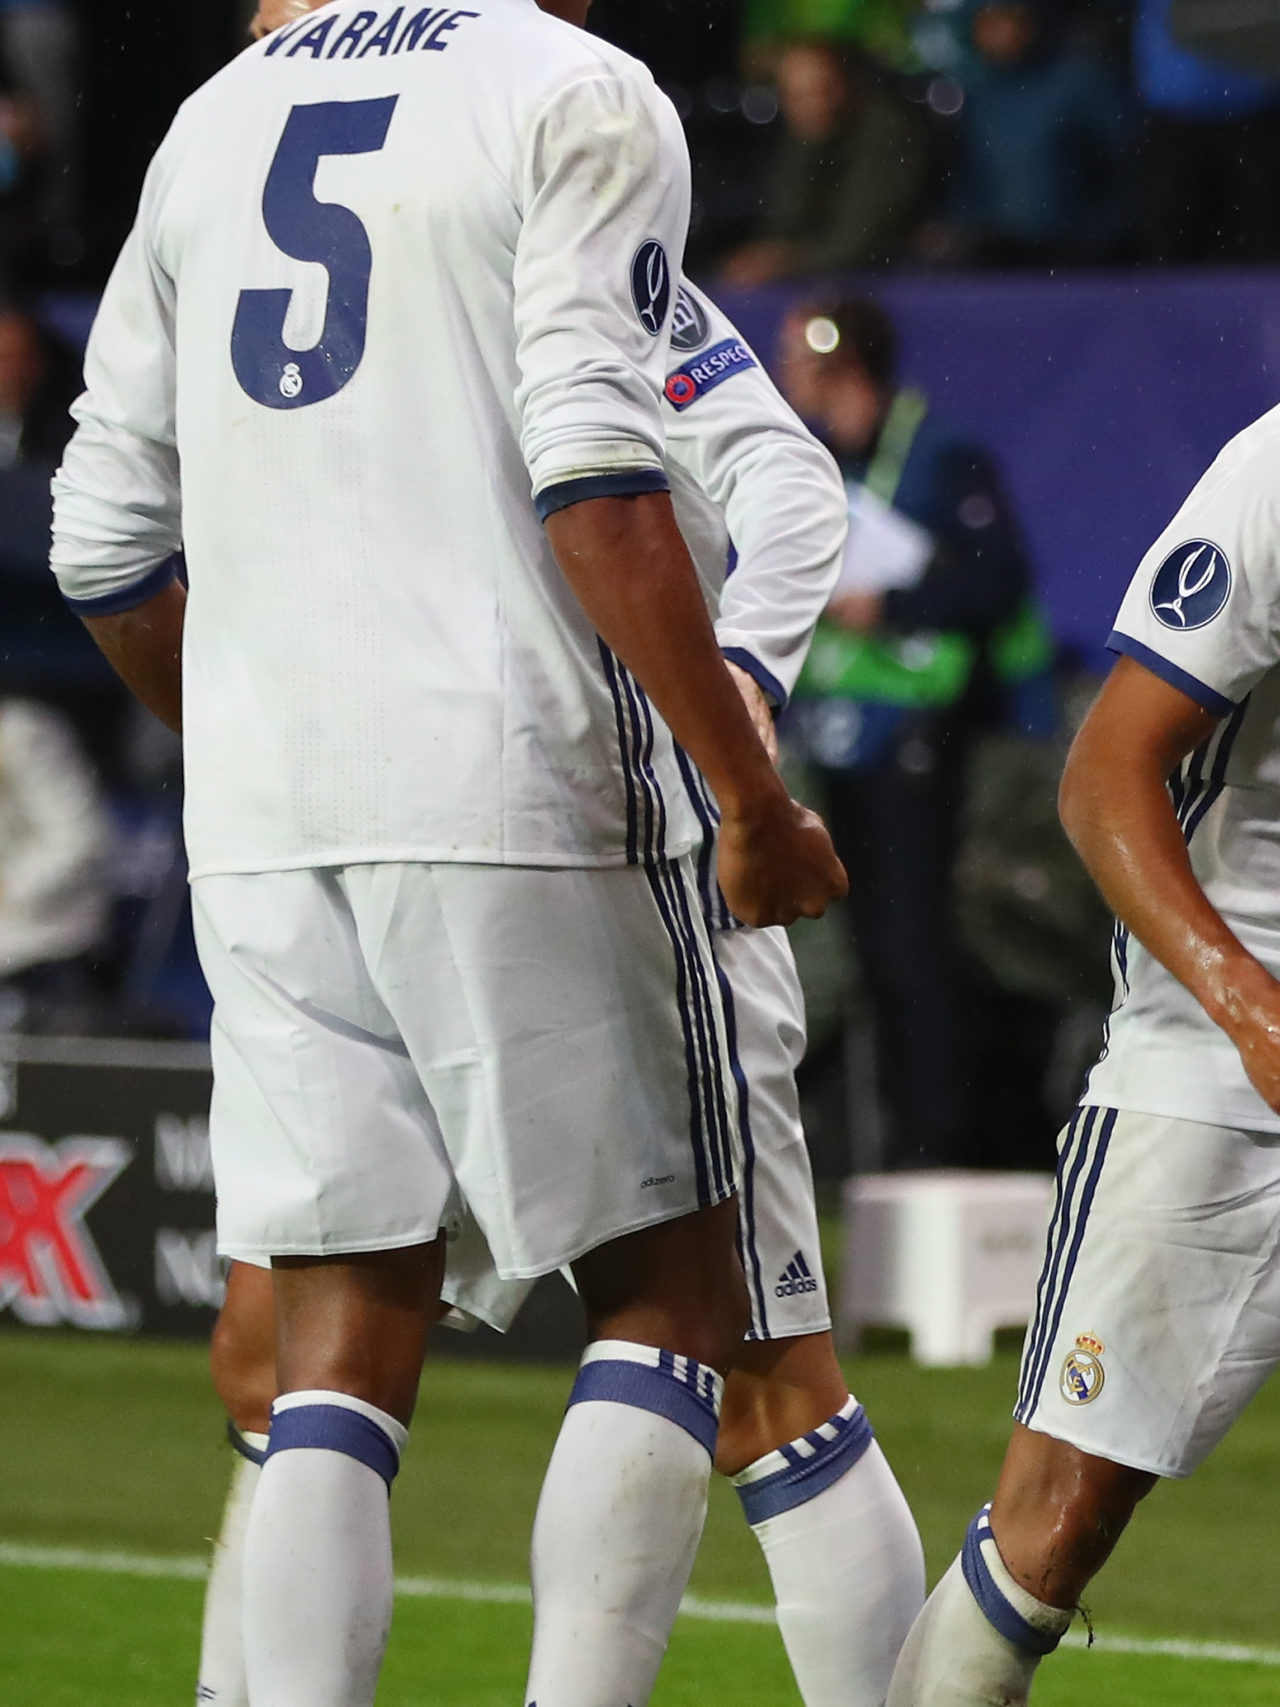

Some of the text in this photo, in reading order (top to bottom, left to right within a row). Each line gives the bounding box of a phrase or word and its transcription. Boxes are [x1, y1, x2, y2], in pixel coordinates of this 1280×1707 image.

[264, 6, 481, 59] VARANE
[231, 93, 400, 410] 5
[690, 344, 750, 384] RESPEC
[640, 1174, 676, 1189] adizero
[775, 1278, 818, 1298] adidas
